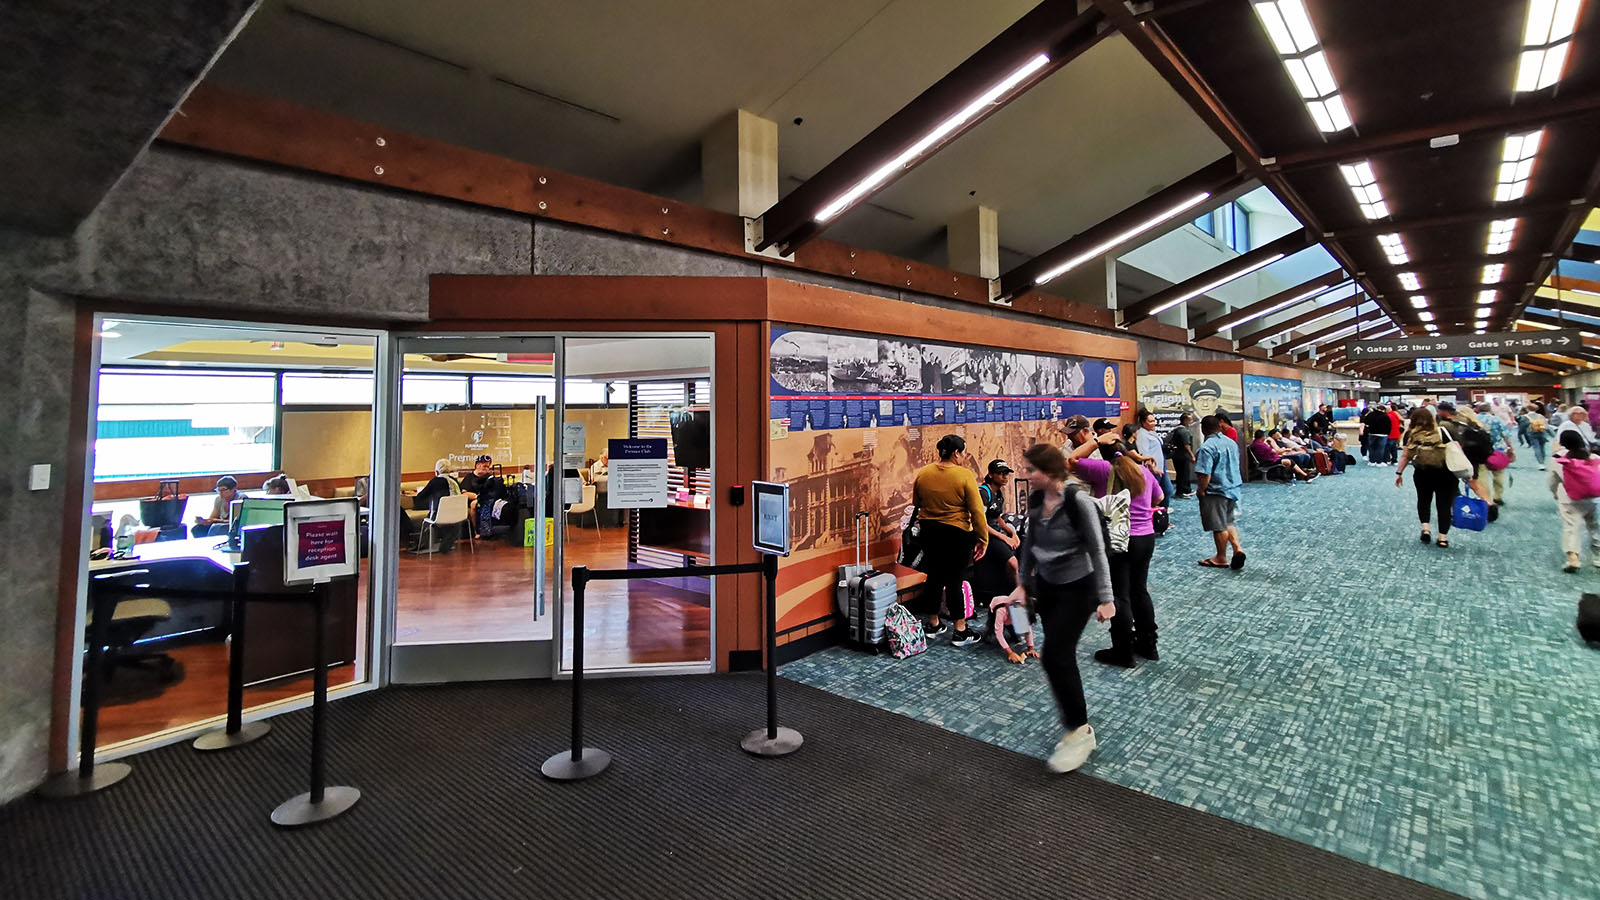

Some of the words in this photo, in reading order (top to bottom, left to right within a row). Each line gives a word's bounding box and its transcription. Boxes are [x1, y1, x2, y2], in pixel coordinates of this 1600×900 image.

[1397, 344, 1409, 352] 22
[1468, 341, 1499, 349] Gates
[1151, 384, 1173, 392] Life
[1152, 394, 1187, 405] Flight
[448, 453, 481, 462] Premier
[484, 453, 506, 461] Club
[763, 513, 778, 522] EXIT
[320, 553, 337, 561] agent
